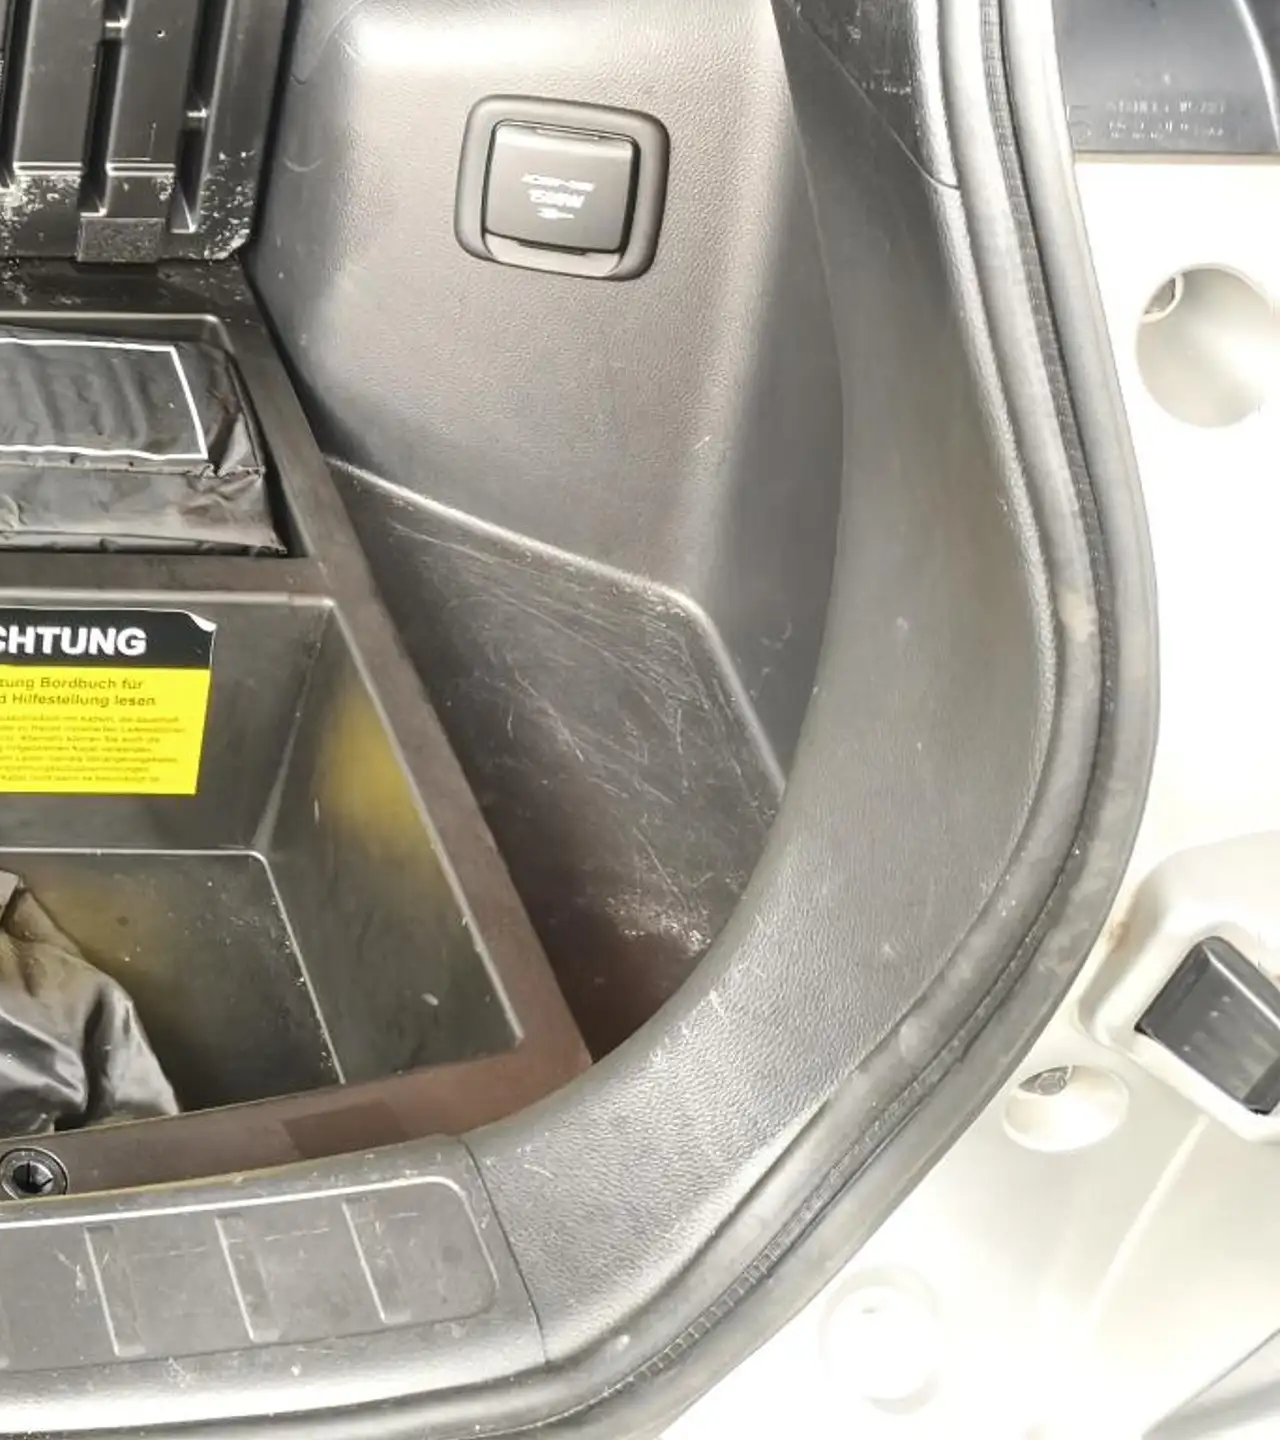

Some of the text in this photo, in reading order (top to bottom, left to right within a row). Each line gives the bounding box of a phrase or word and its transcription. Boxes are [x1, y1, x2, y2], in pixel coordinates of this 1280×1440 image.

[40, 677, 117, 690] Bordbuch
[12, 693, 111, 708] Hilfestellung
[115, 695, 156, 707] lesen
